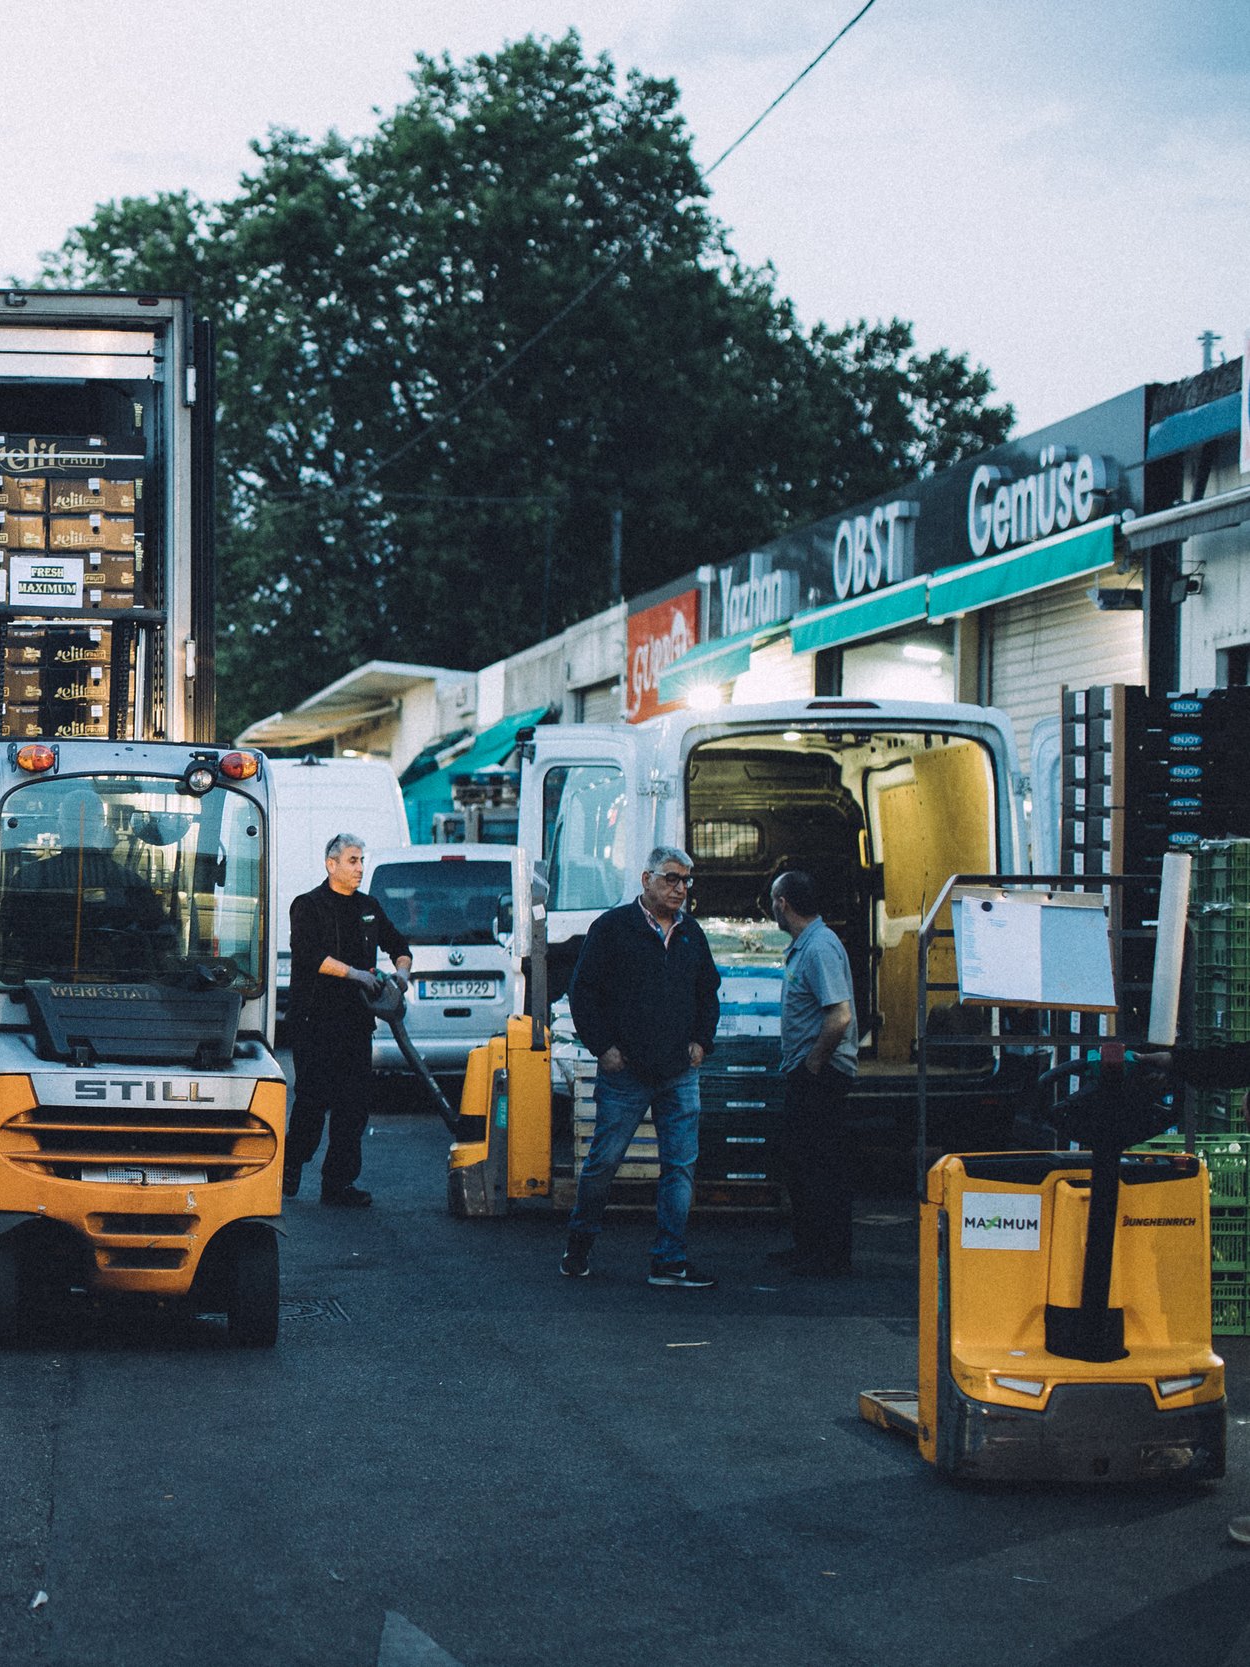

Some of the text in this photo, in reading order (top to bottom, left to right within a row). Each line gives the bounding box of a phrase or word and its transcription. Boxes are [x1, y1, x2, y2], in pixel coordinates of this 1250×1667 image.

[968, 445, 1094, 557] Gemüse
[833, 501, 900, 600] OBST
[31, 567, 64, 578] FRESH
[19, 583, 76, 595] MAXIMUM
[720, 553, 782, 637] Yazhan
[1174, 736, 1200, 744] ENJOY
[430, 982, 489, 996] S TG 929
[75, 1080, 215, 1102] STILL
[1122, 1215, 1196, 1227] JUNGHEINRICH
